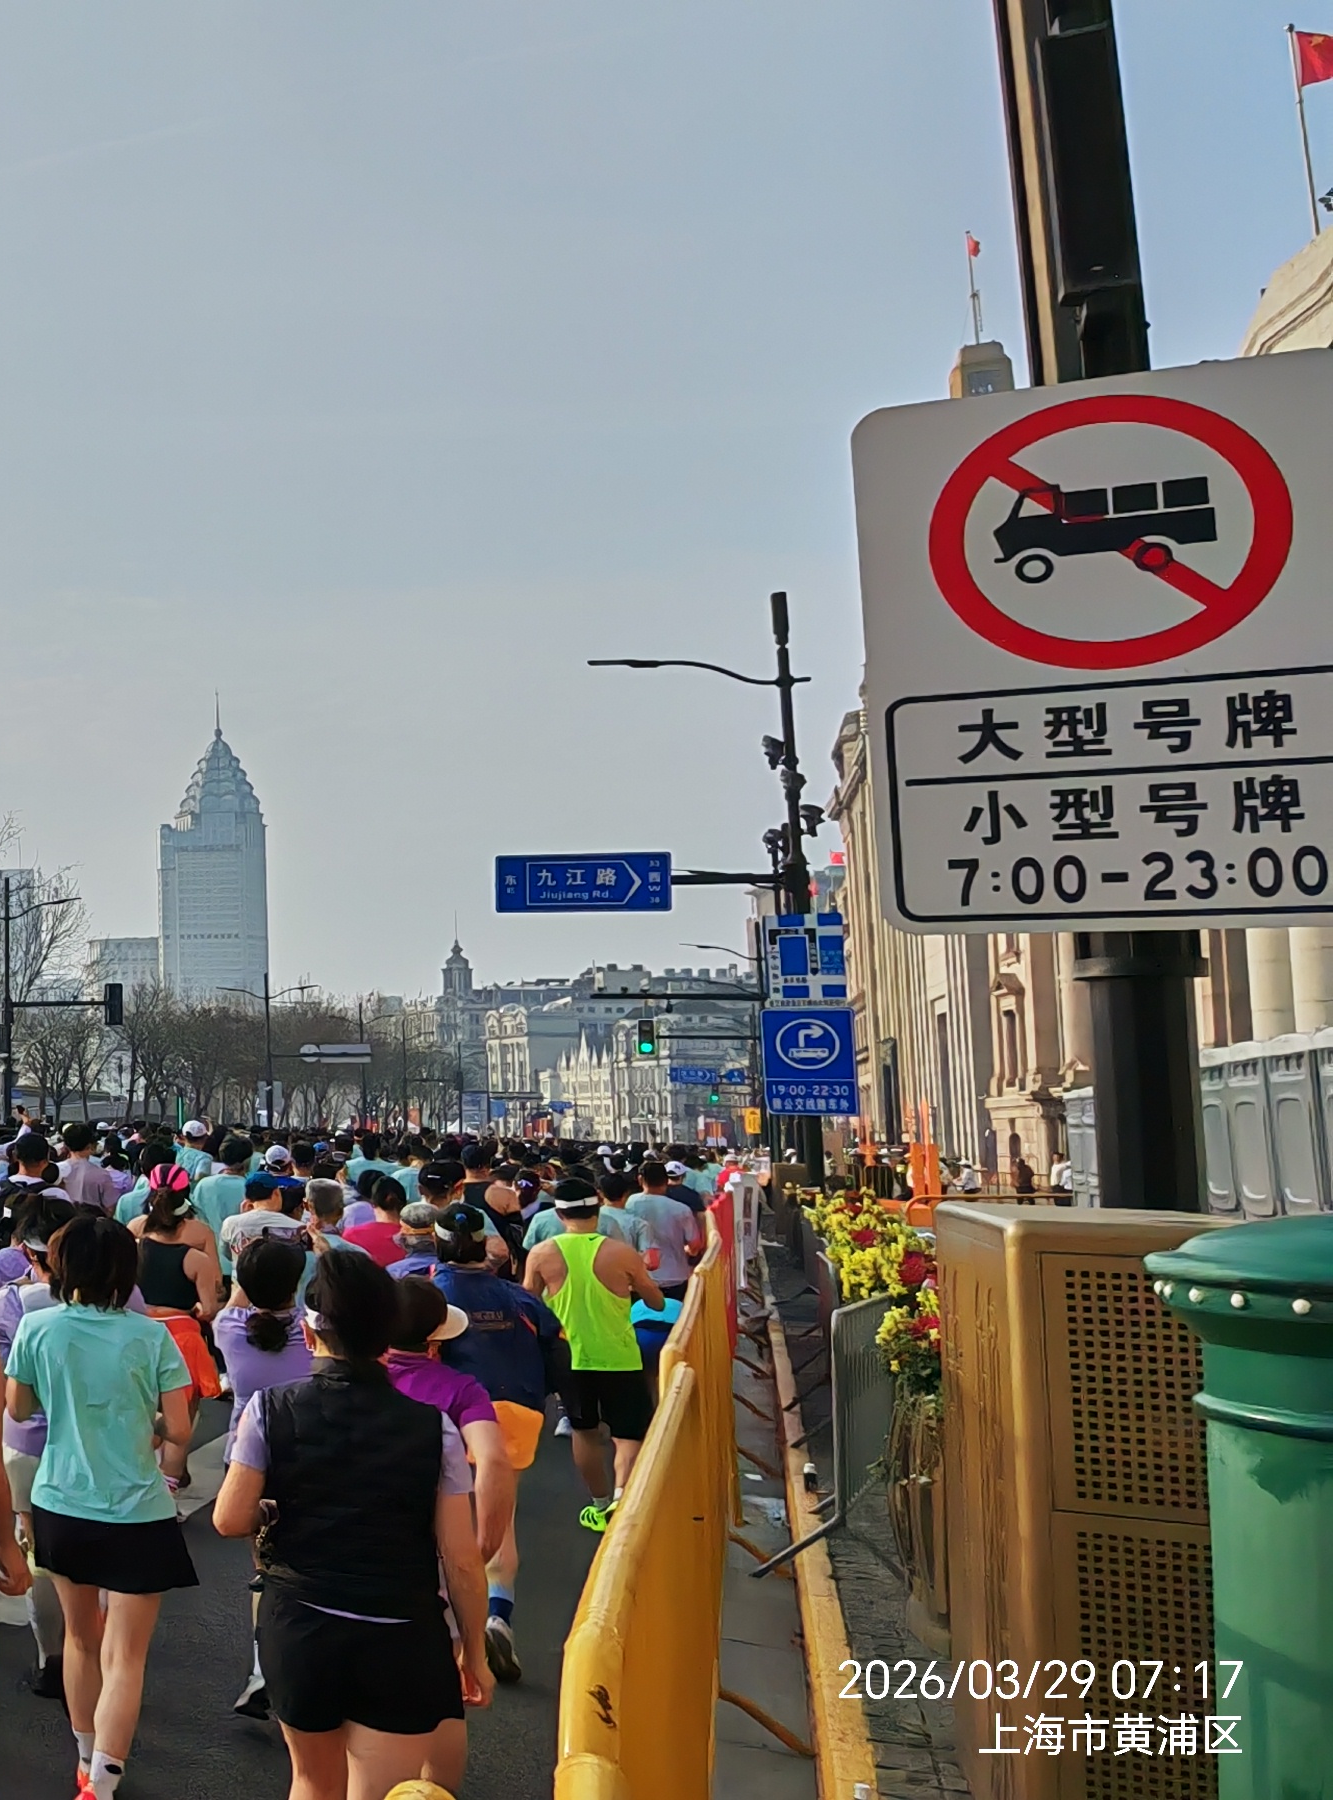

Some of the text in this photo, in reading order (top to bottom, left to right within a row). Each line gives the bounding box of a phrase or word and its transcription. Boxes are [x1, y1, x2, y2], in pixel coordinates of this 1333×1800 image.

[957, 690, 1298, 764] 大型号牌
[963, 774, 1306, 845] 小型号牌
[504, 875, 517, 886] 东
[536, 867, 617, 887] 九江路
[948, 845, 1329, 907] 7:00-23:00
[539, 890, 614, 900] Jiujiang Rd.
[772, 1085, 849, 1096] 19:00-22:30
